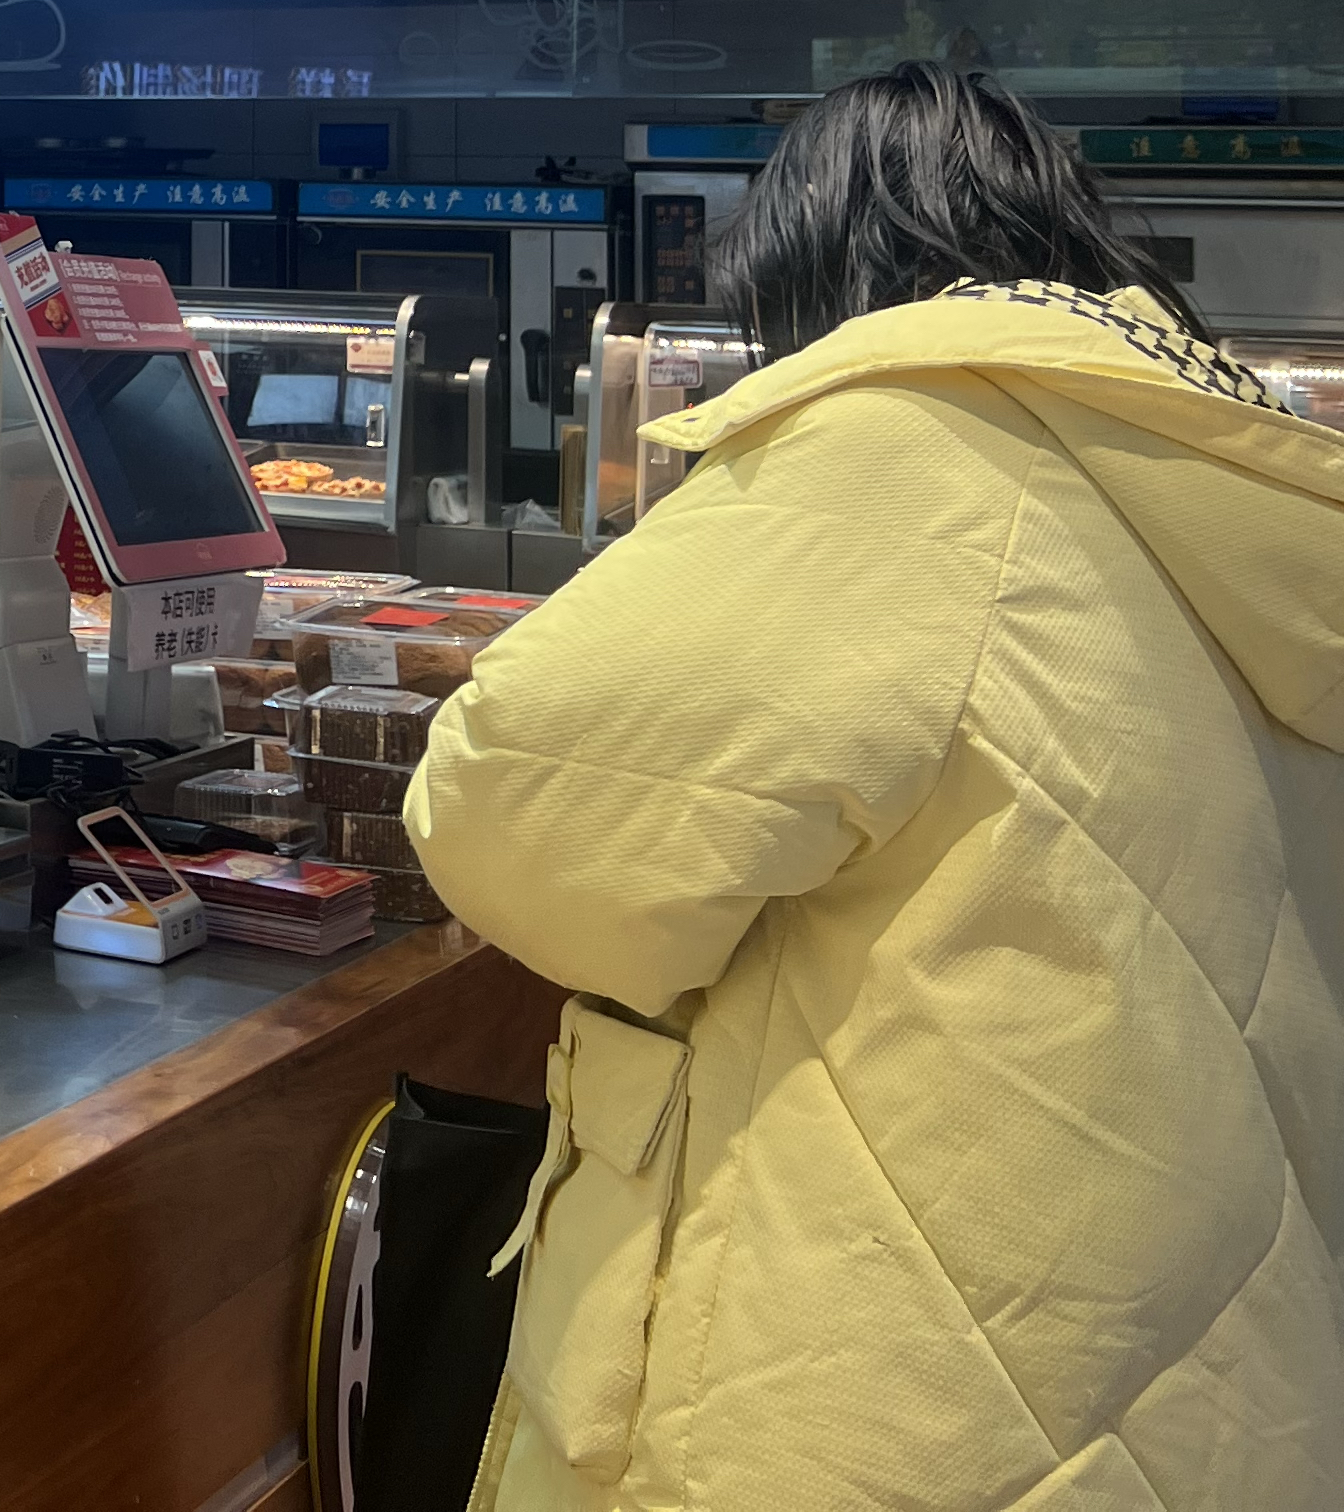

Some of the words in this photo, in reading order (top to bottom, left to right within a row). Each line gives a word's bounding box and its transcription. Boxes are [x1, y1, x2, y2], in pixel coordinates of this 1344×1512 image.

[66, 183, 149, 205] 安全生产
[167, 183, 251, 206] 注意高温
[370, 189, 463, 213] 安全生产
[484, 189, 579, 215] 注意高温
[160, 587, 216, 621] 本店可使用
